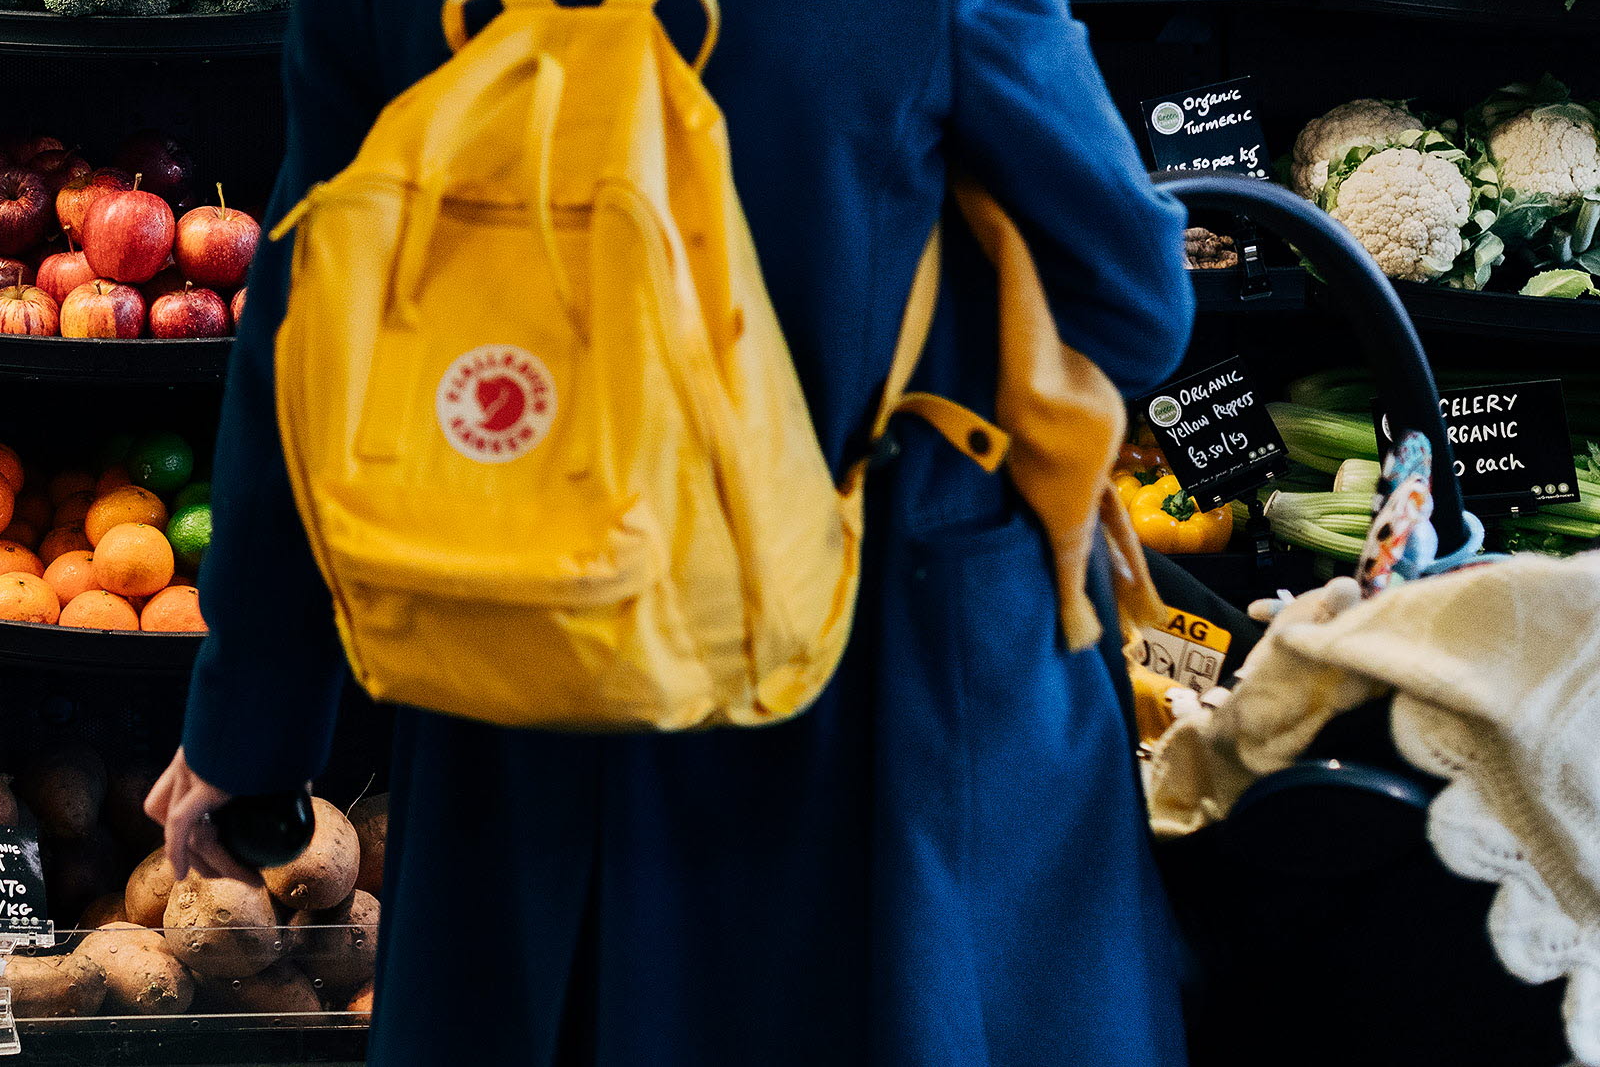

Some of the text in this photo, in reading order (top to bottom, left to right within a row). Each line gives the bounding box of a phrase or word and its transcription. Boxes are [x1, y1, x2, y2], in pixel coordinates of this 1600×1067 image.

[1182, 89, 1242, 116] Organic
[1179, 370, 1244, 406] ORGANIC
[1438, 393, 1518, 418] CELERY
[1166, 391, 1254, 447] Yellow Peppers
[1446, 421, 1518, 445] RGANIC
[1475, 452, 1526, 474] each
